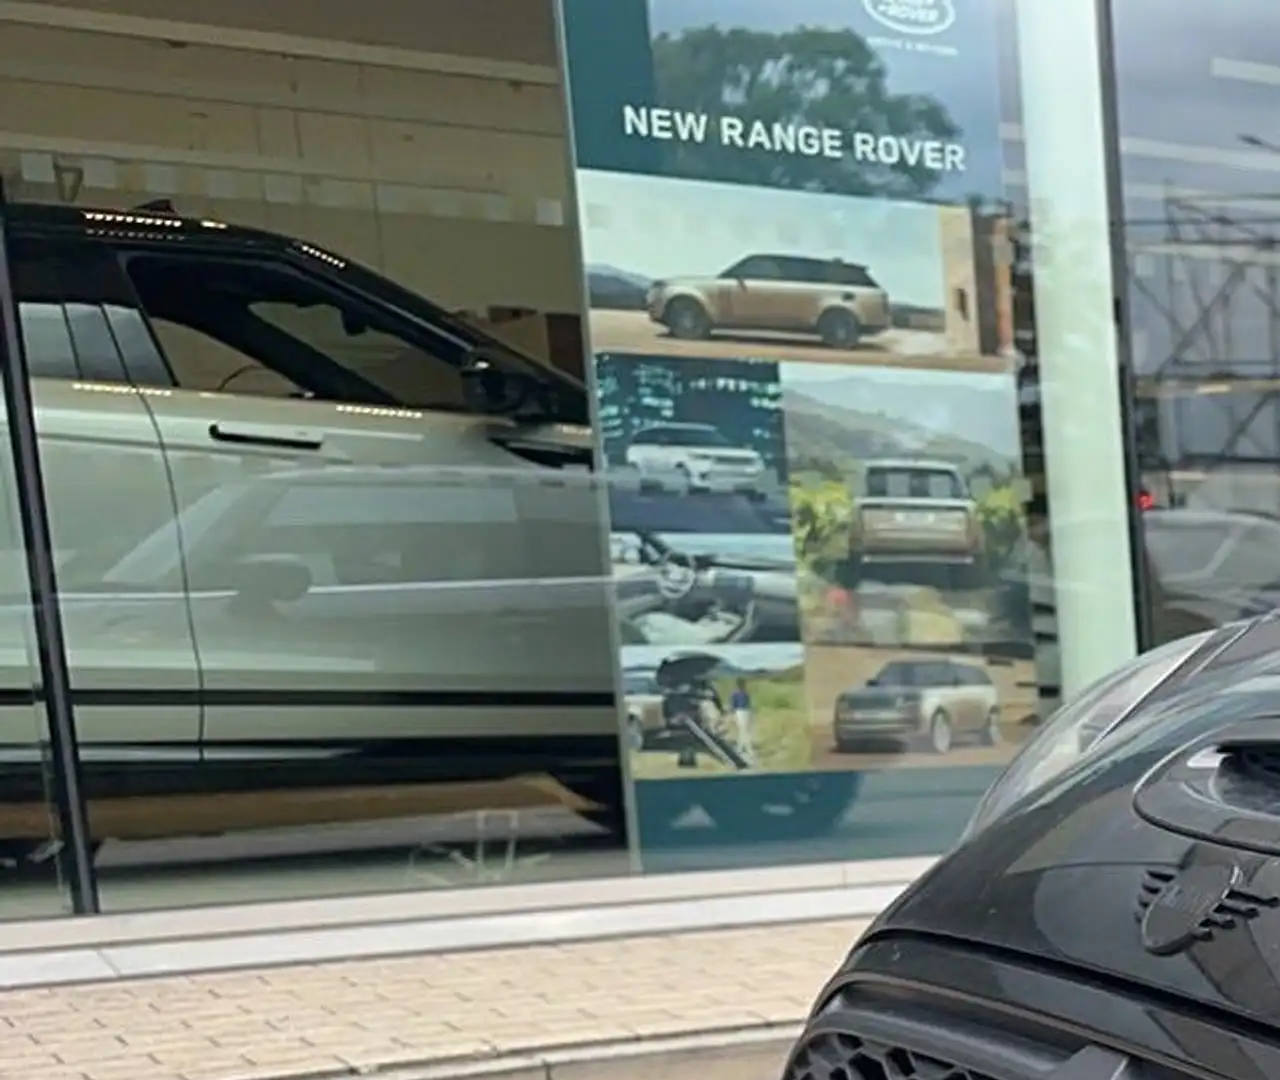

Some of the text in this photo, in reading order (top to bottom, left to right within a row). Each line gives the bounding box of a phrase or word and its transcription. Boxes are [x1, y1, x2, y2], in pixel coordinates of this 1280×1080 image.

[623, 104, 967, 171] NEW RANGE ROVER
